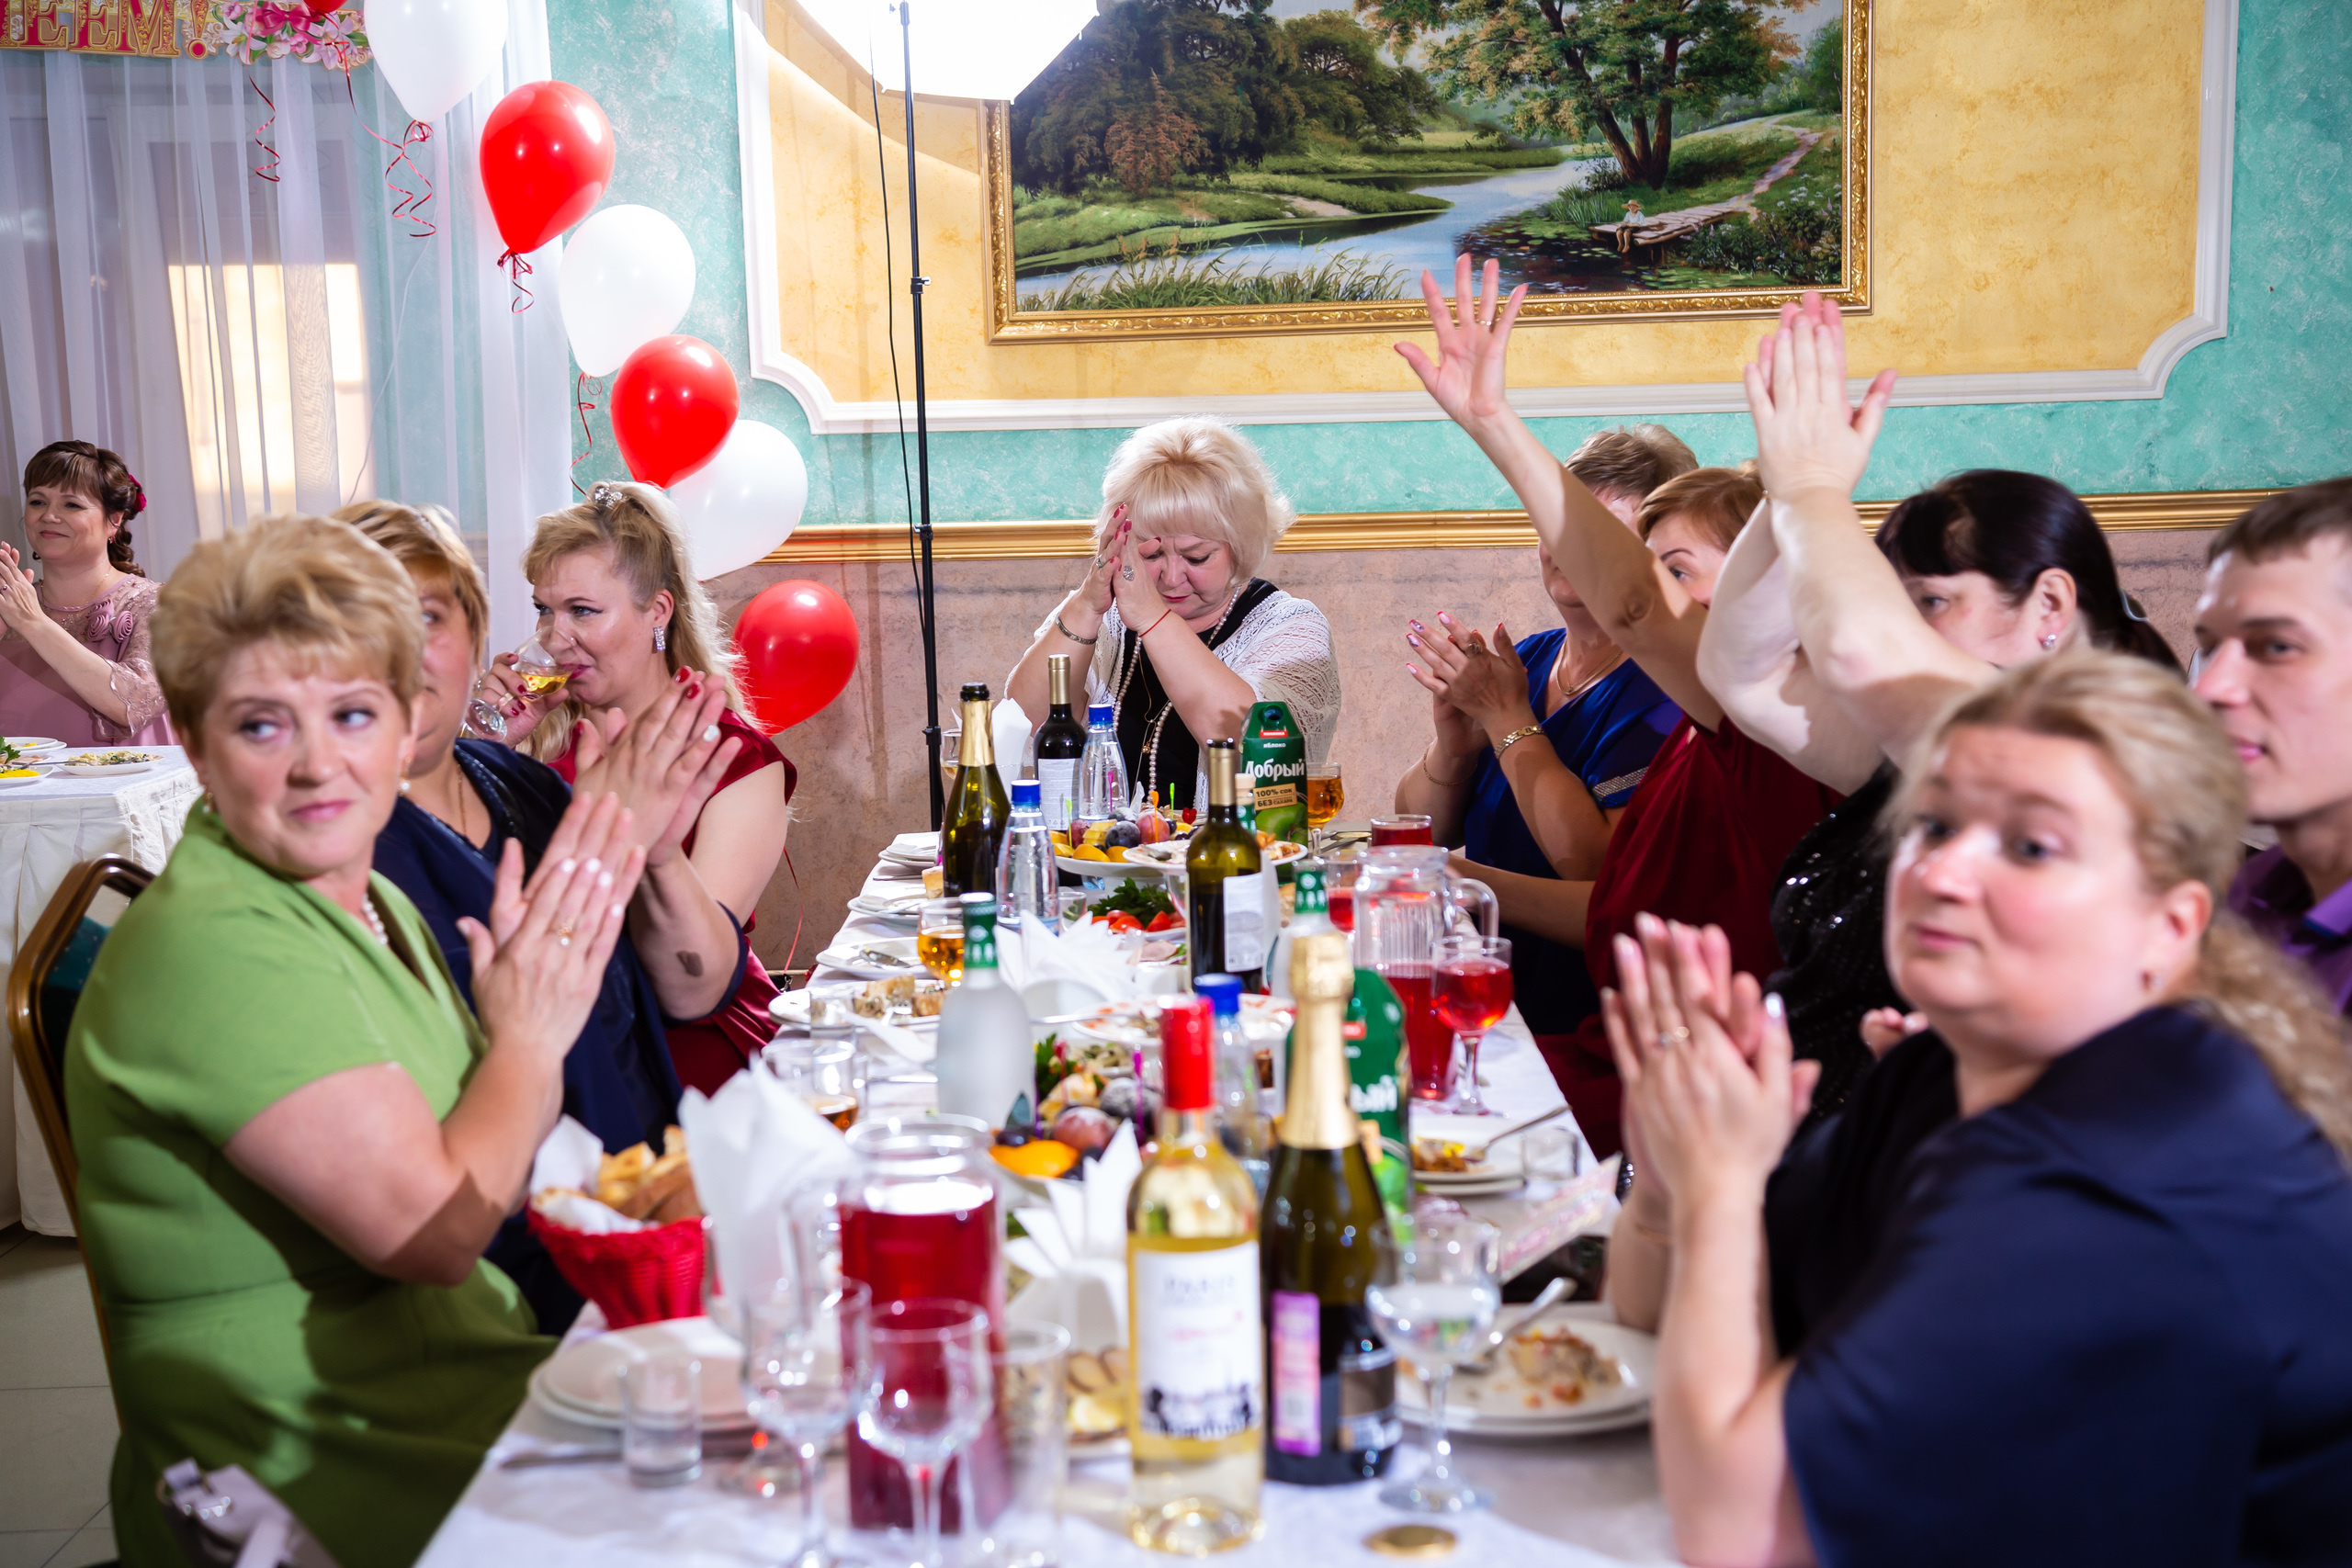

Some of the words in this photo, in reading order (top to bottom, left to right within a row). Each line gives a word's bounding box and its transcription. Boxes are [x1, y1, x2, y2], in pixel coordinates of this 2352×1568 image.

[0, 0, 209, 60] ЕЕМ!
[1245, 758, 1305, 782] Добрый
[1256, 789, 1279, 797] 100%
[1257, 799, 1272, 807] БЕЗ
